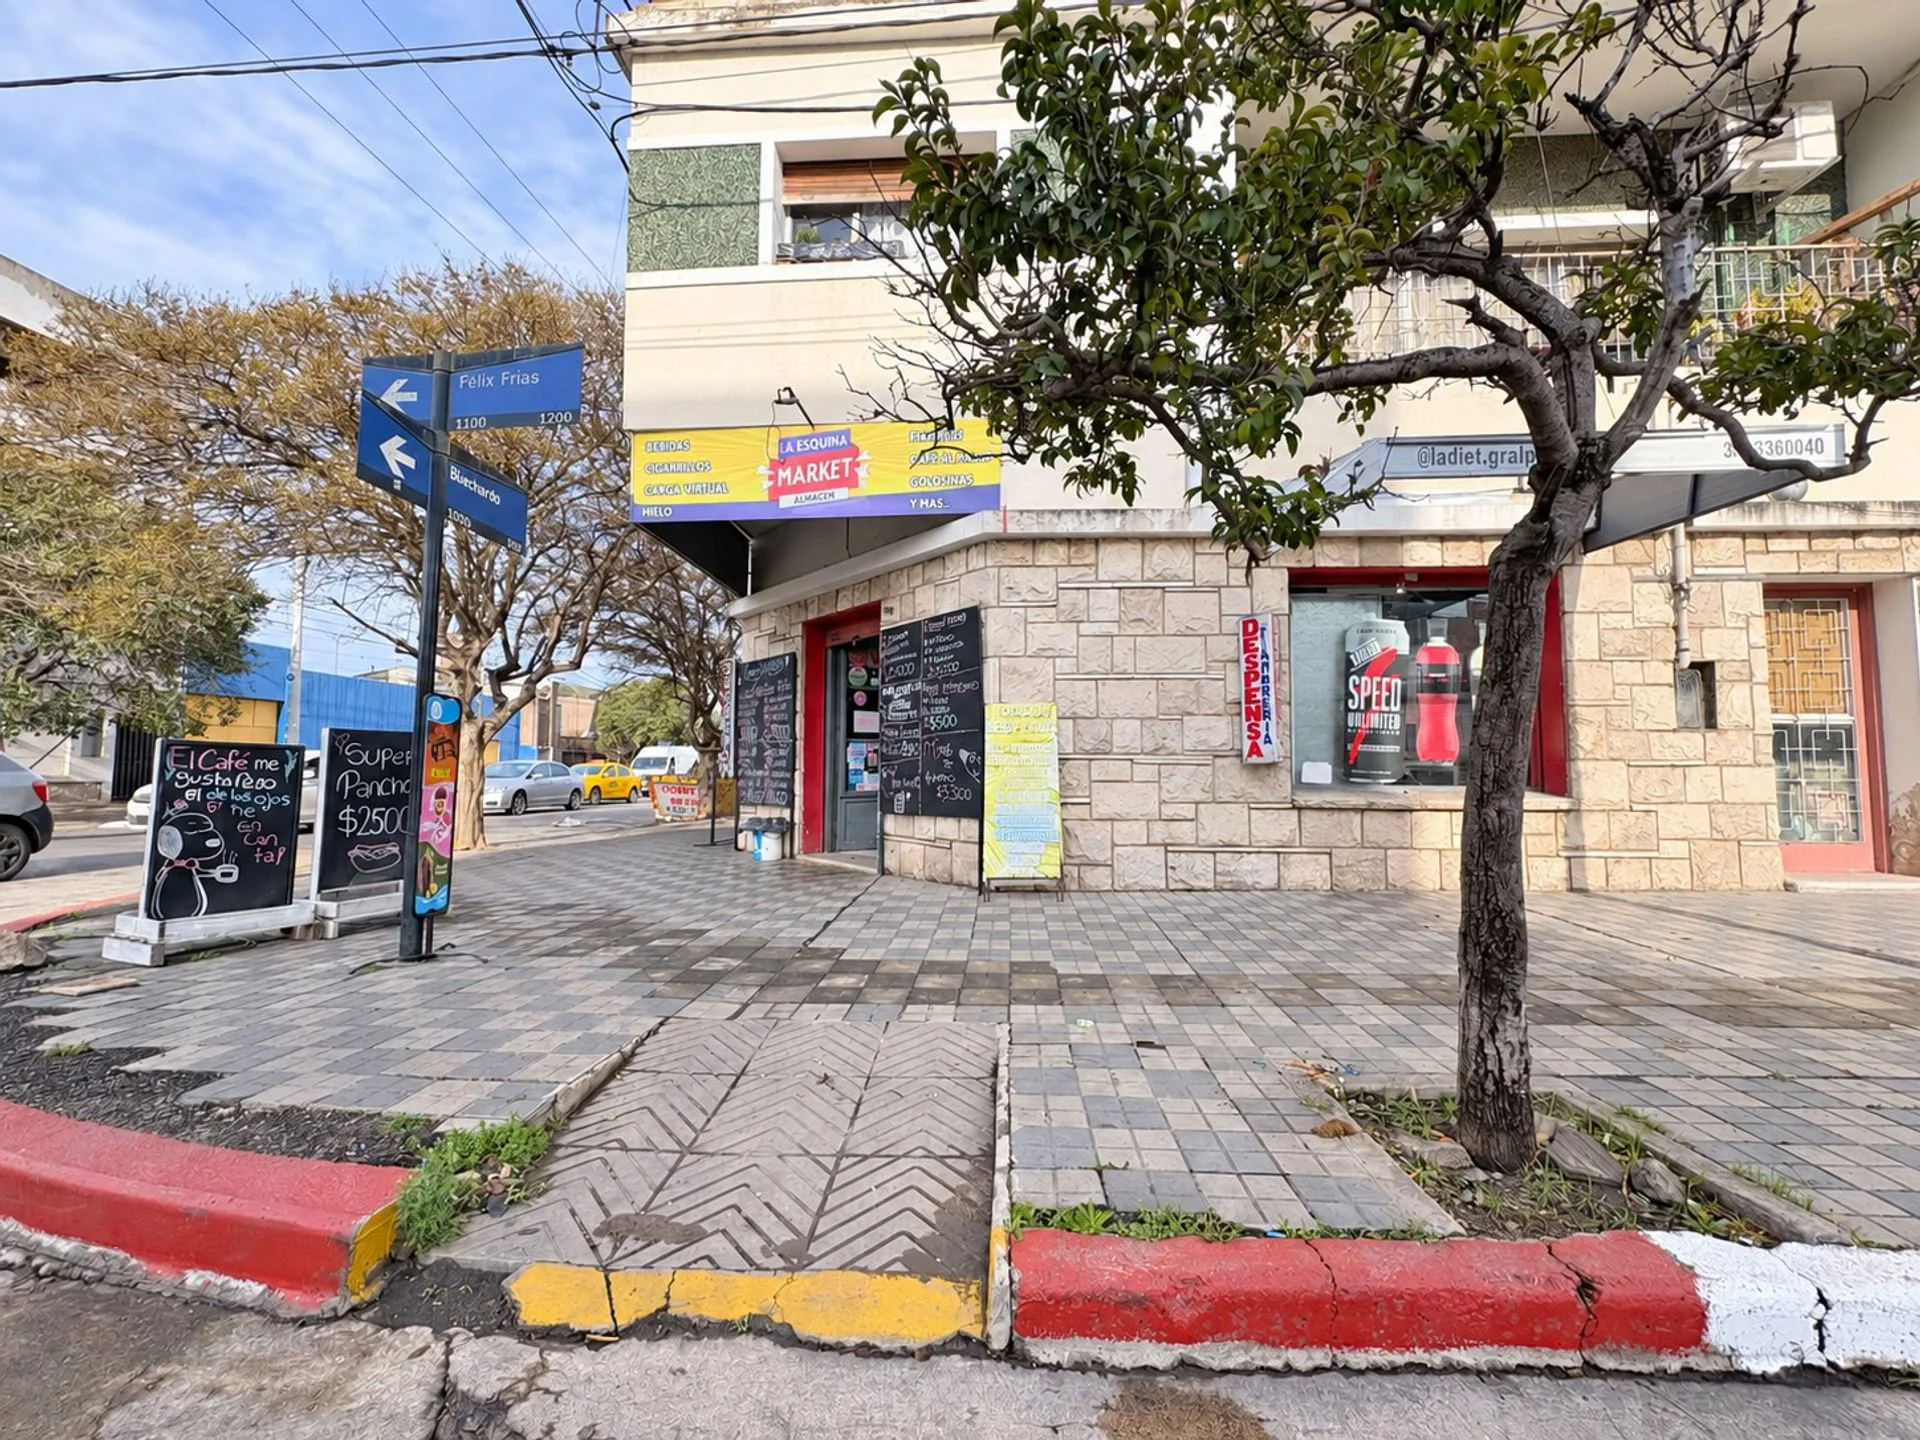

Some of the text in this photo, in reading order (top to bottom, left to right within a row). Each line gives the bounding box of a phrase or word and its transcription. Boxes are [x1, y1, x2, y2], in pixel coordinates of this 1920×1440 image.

[456, 416, 487, 429] 1100
[539, 411, 573, 425] 1200
[779, 434, 848, 454] LA ESQUINA
[1723, 437, 1824, 458] 33360040
[1418, 445, 1536, 469] @ladiet.gralp
[777, 456, 853, 488] MARKET
[642, 505, 673, 517] HIELO
[1241, 616, 1265, 760] DESPENSA
[1348, 674, 1402, 711] SPEED
[1347, 711, 1401, 730] UNLIMITED
[198, 748, 251, 771] Café
[254, 757, 280, 771] me
[174, 771, 232, 789] gusta
[230, 788, 252, 802] los
[254, 792, 291, 811] ojos
